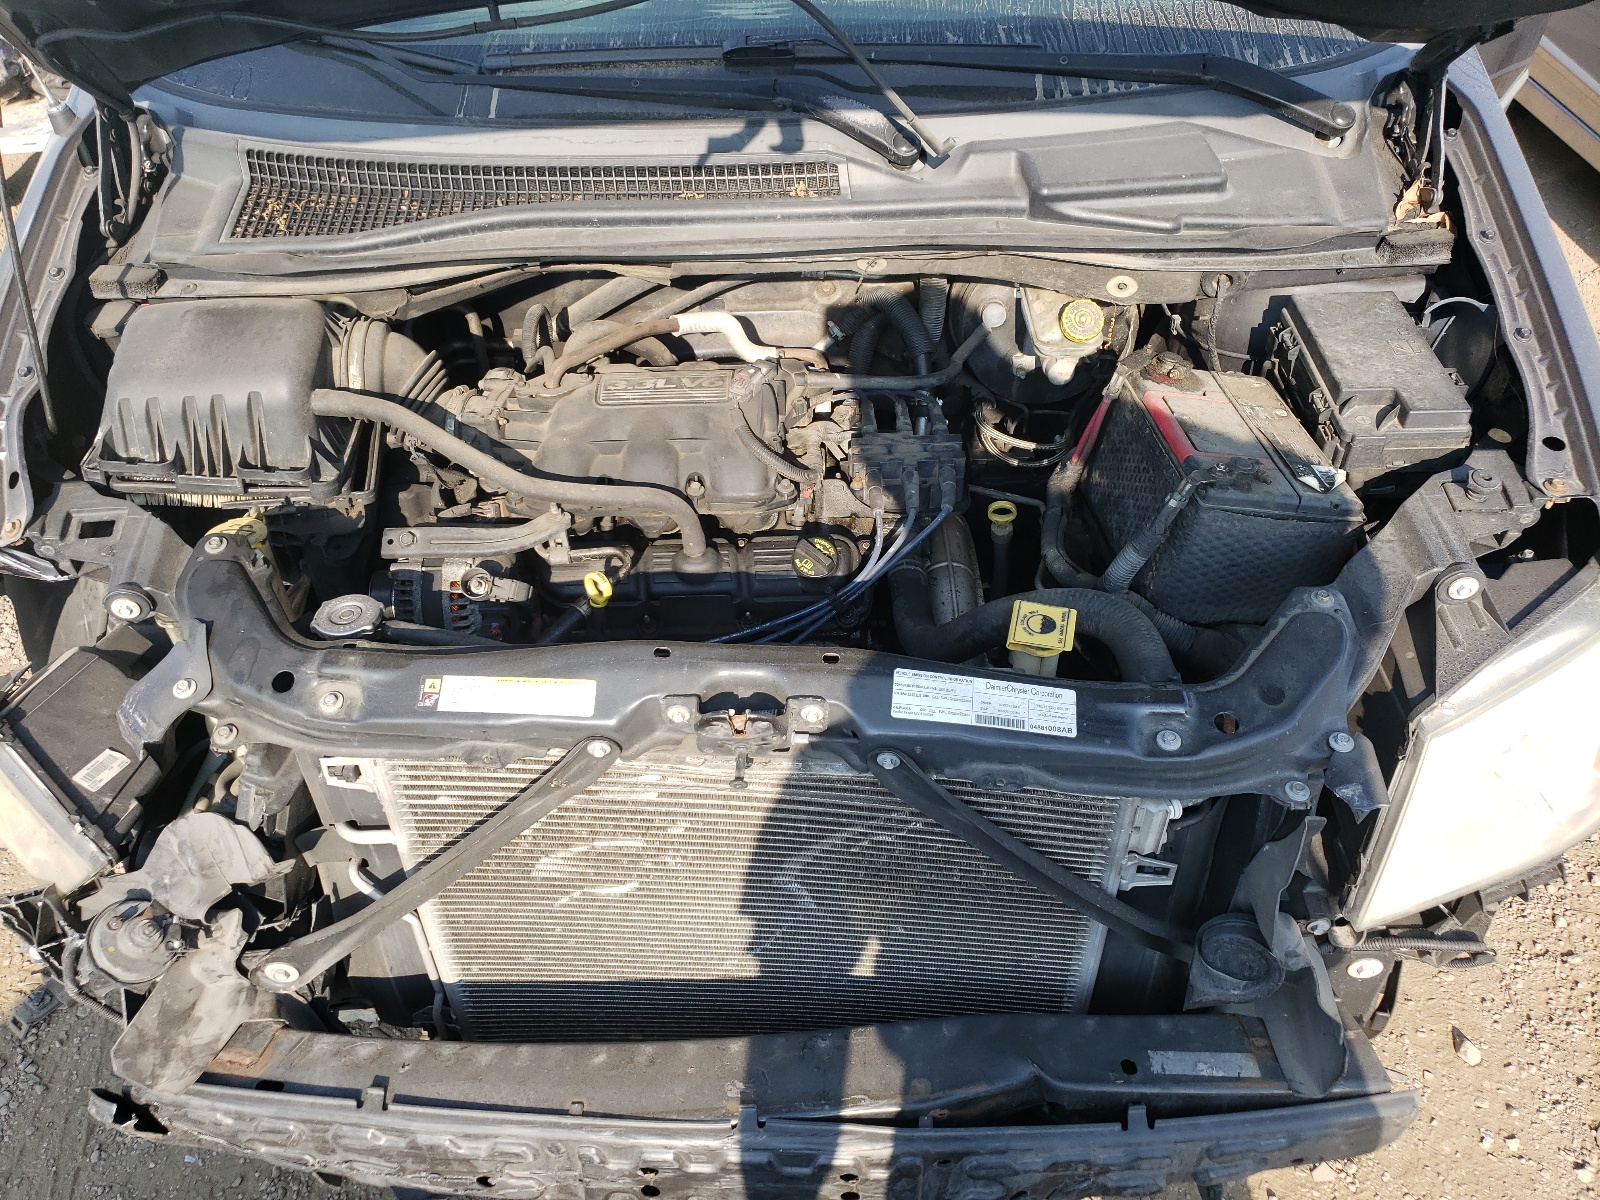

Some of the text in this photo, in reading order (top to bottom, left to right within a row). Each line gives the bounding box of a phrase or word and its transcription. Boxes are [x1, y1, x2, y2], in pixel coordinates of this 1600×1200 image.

[607, 377, 724, 390] 3.3L V6
[985, 681, 1063, 699] DaimlerChrysler Corporation
